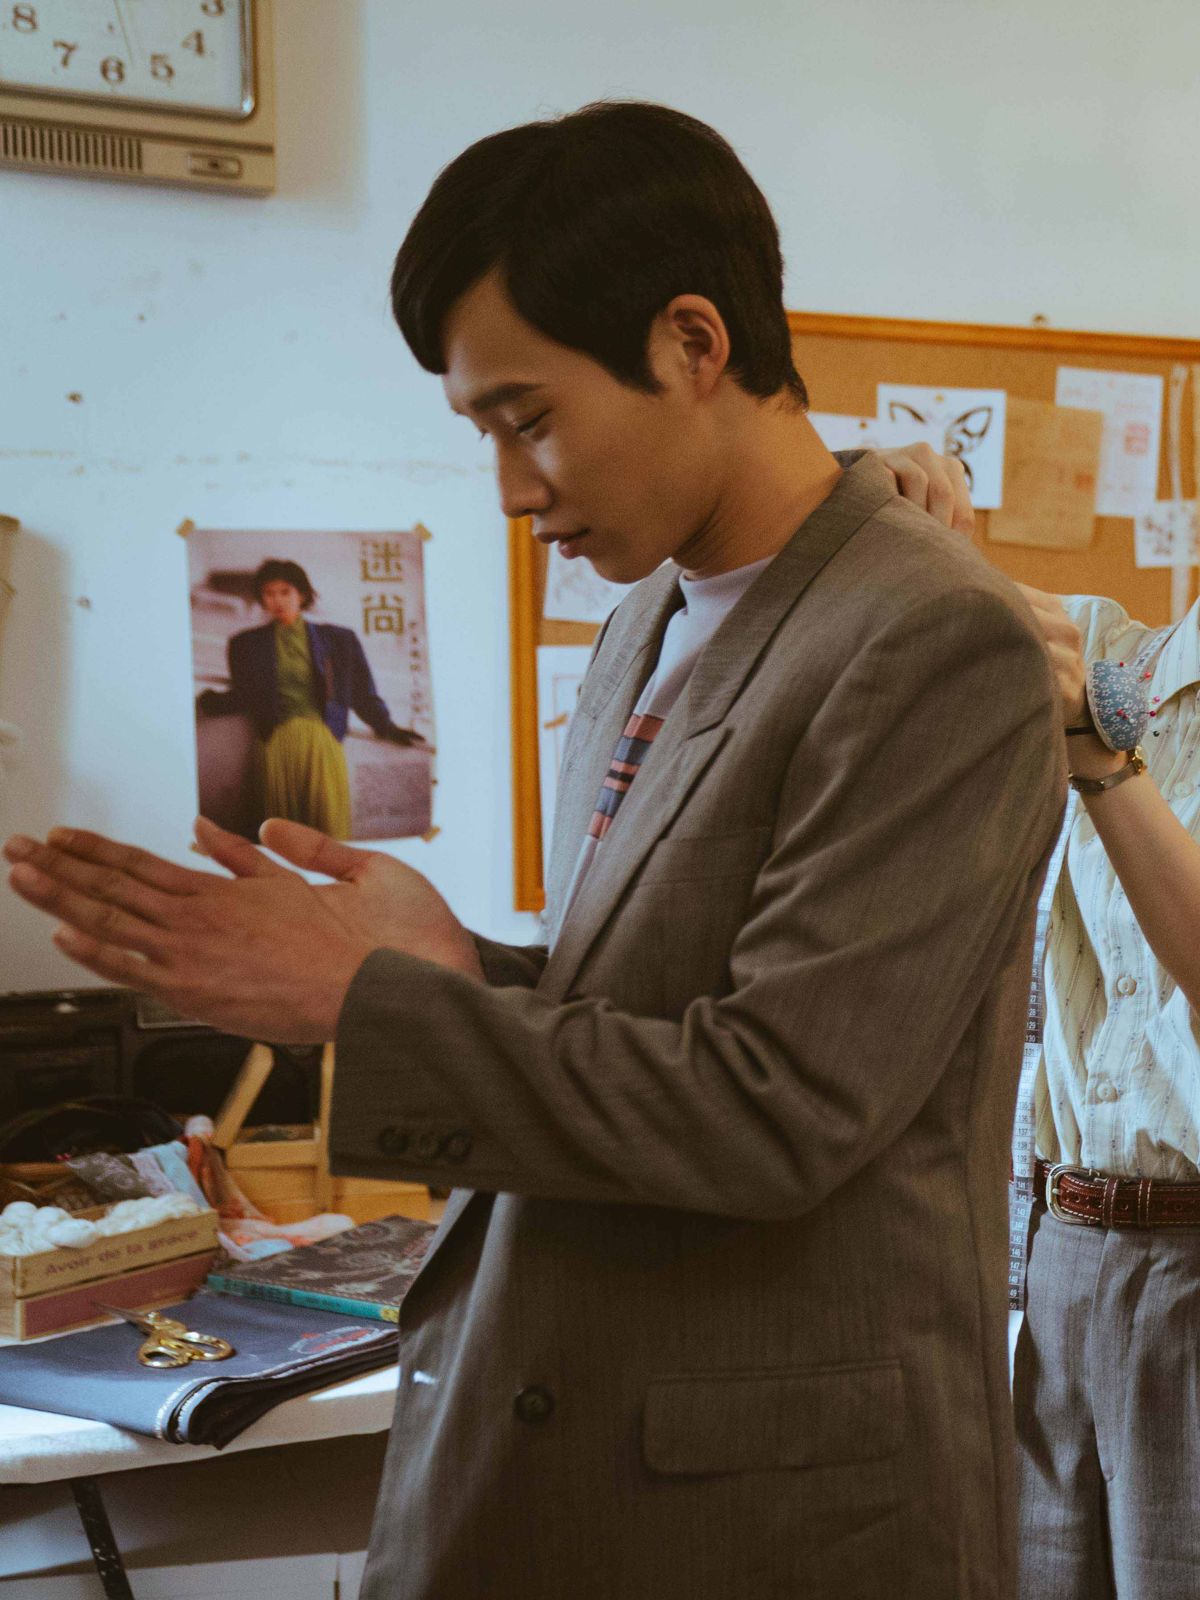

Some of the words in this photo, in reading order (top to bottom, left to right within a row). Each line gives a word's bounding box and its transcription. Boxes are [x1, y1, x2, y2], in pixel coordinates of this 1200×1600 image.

[12, 3, 38, 33] 8
[54, 40, 77, 67] 7
[182, 30, 205, 57] 4
[101, 56, 125, 85] 6
[151, 54, 174, 82] 5
